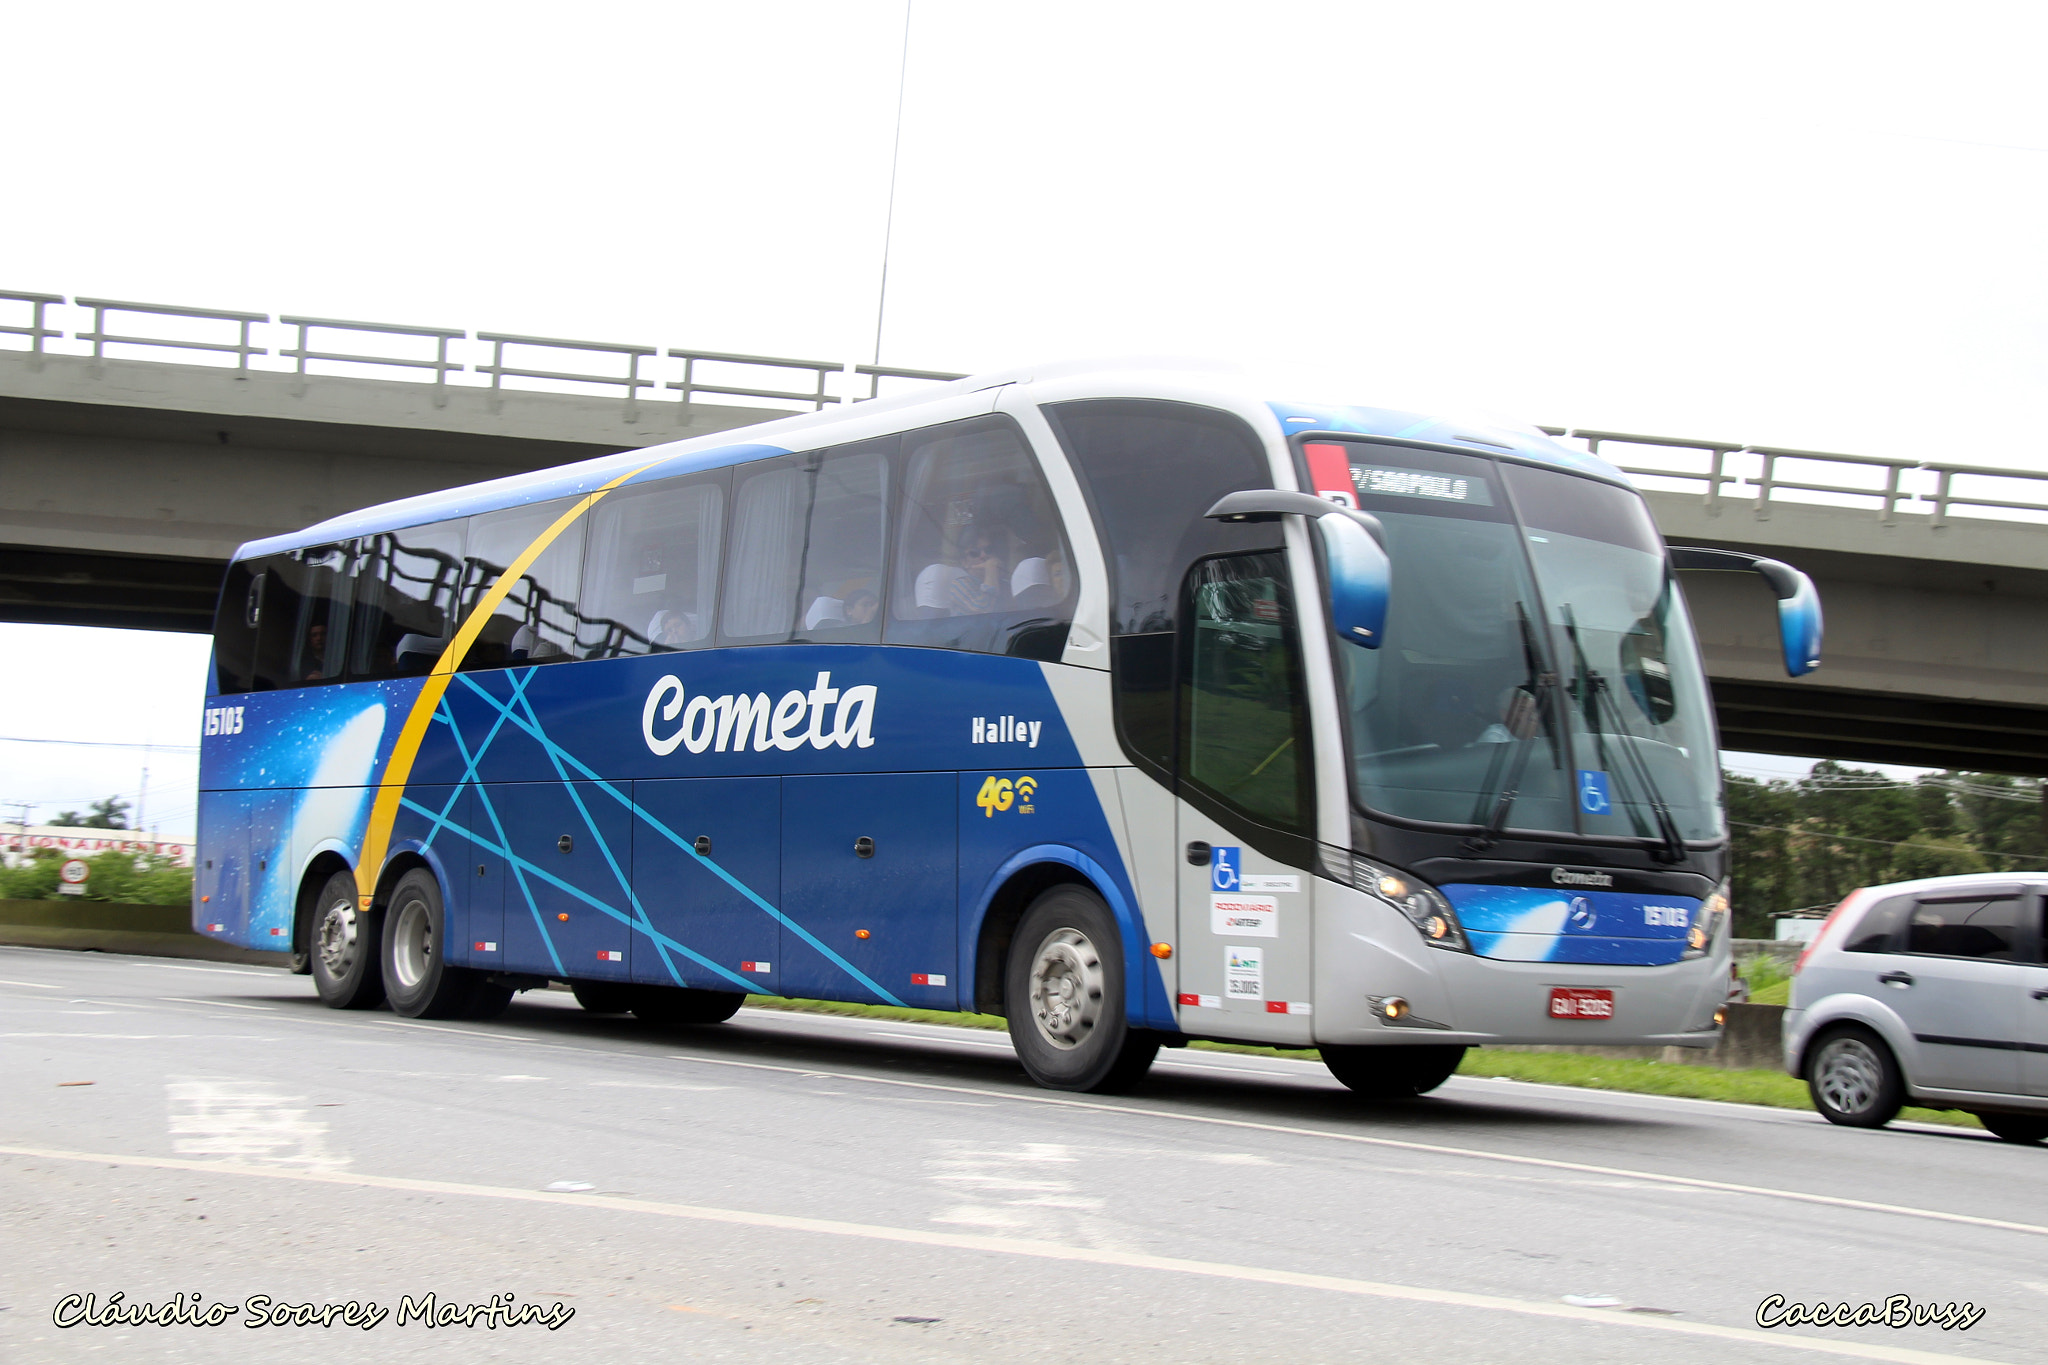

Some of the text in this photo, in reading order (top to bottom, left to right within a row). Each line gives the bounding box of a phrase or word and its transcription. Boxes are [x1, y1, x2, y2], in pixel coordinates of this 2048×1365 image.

[204, 706, 245, 736] 15103
[642, 671, 878, 756] Cometa
[972, 715, 1042, 748] Halley
[976, 775, 1015, 818] 4G
[1551, 866, 1614, 888] Cometa
[1643, 905, 1689, 928] 15103
